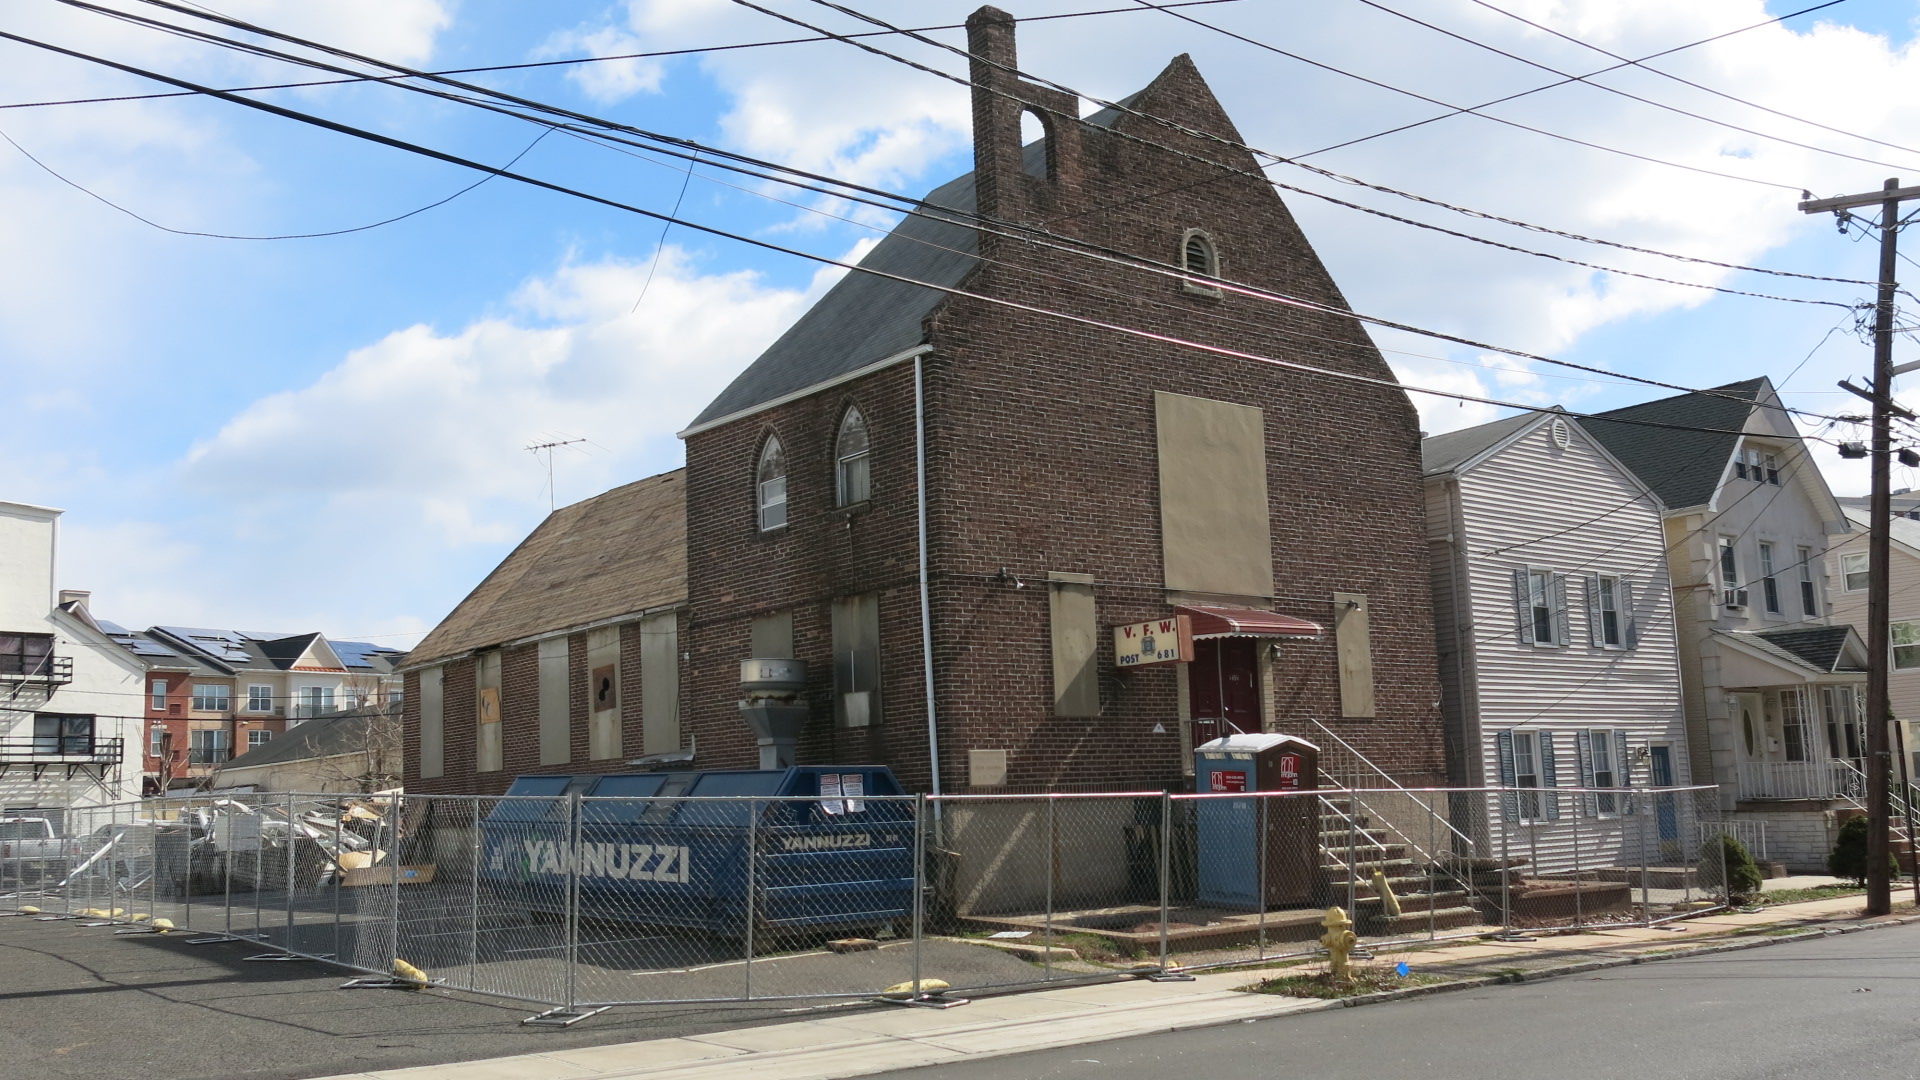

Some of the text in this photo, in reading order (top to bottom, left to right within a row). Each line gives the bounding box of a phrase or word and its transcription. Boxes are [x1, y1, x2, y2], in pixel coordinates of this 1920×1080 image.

[1124, 620, 1175, 638] V. F. W.
[1120, 649, 1174, 664] POST 681
[782, 834, 870, 850] YANNUZZI
[524, 840, 689, 883] YANNUZZI
